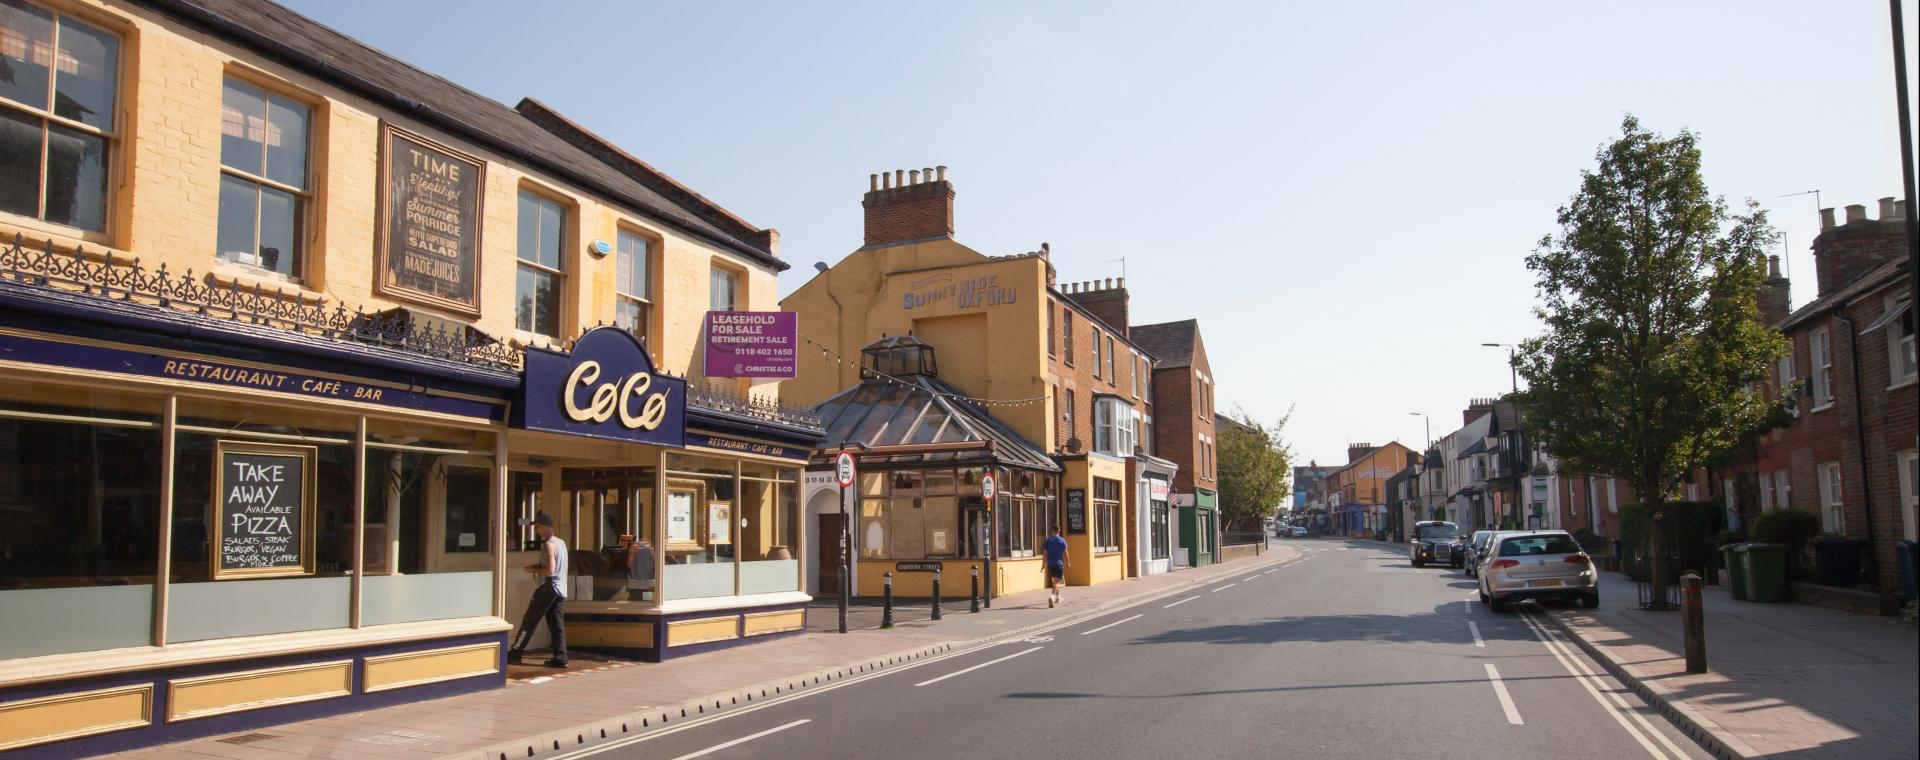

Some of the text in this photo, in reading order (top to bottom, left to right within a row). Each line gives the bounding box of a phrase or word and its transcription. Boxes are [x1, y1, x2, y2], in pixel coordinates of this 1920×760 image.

[410, 149, 460, 182] TIME
[406, 197, 460, 224] Summer
[406, 208, 462, 237] PORRIDGE
[408, 237, 457, 258] SALAD
[404, 256, 460, 284] MADE JUICES
[712, 315, 776, 324] LEASEHOLD
[712, 325, 763, 335] FOR SALE
[766, 336, 788, 344] SALE
[773, 348, 793, 356] 1650
[163, 360, 382, 401] RESTAURANT CAFÉ BAR
[707, 437, 748, 450] RESTAURANT
[771, 447, 784, 455] BAR
[232, 462, 284, 482] TAKE
[228, 485, 279, 509] AWAY
[245, 505, 292, 514] AVAILABLE
[231, 513, 292, 535] PIZZA
[261, 545, 287, 554] VEGAN
[265, 536, 292, 544] STEAK
[271, 554, 299, 563] COFFEE
